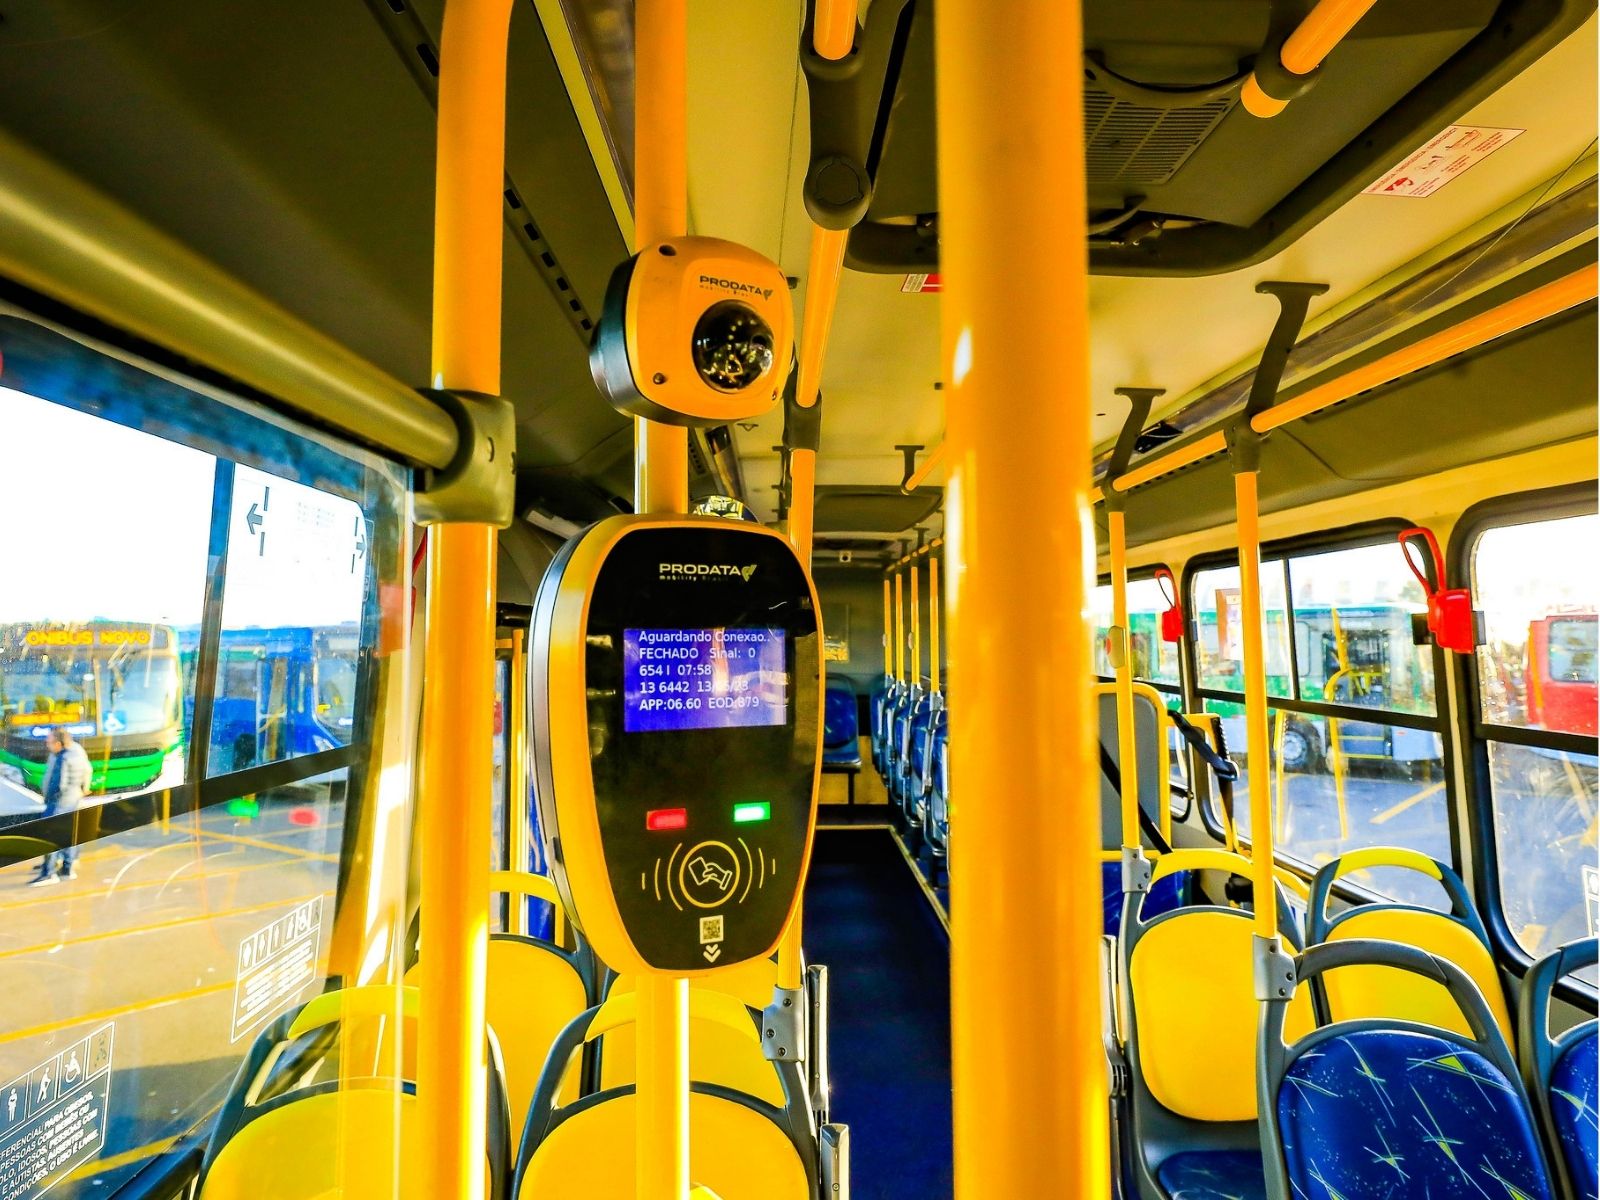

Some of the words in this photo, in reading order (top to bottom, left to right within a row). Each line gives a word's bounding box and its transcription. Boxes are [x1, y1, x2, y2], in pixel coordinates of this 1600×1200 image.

[700, 275, 762, 295] PRODATA
[659, 563, 741, 576] PRODATA
[26, 630, 95, 646] ONIBUS
[100, 630, 151, 645] NOVO
[639, 630, 711, 644] Aguardando
[639, 647, 699, 660] FECHADO
[709, 647, 741, 659] Sinal:
[748, 647, 756, 659] 0
[677, 664, 712, 676] 07:58
[639, 681, 656, 693] 13
[659, 681, 690, 693] 6442
[639, 698, 702, 711] APP:06.60
[0, 1140, 37, 1171] PESSOAS
